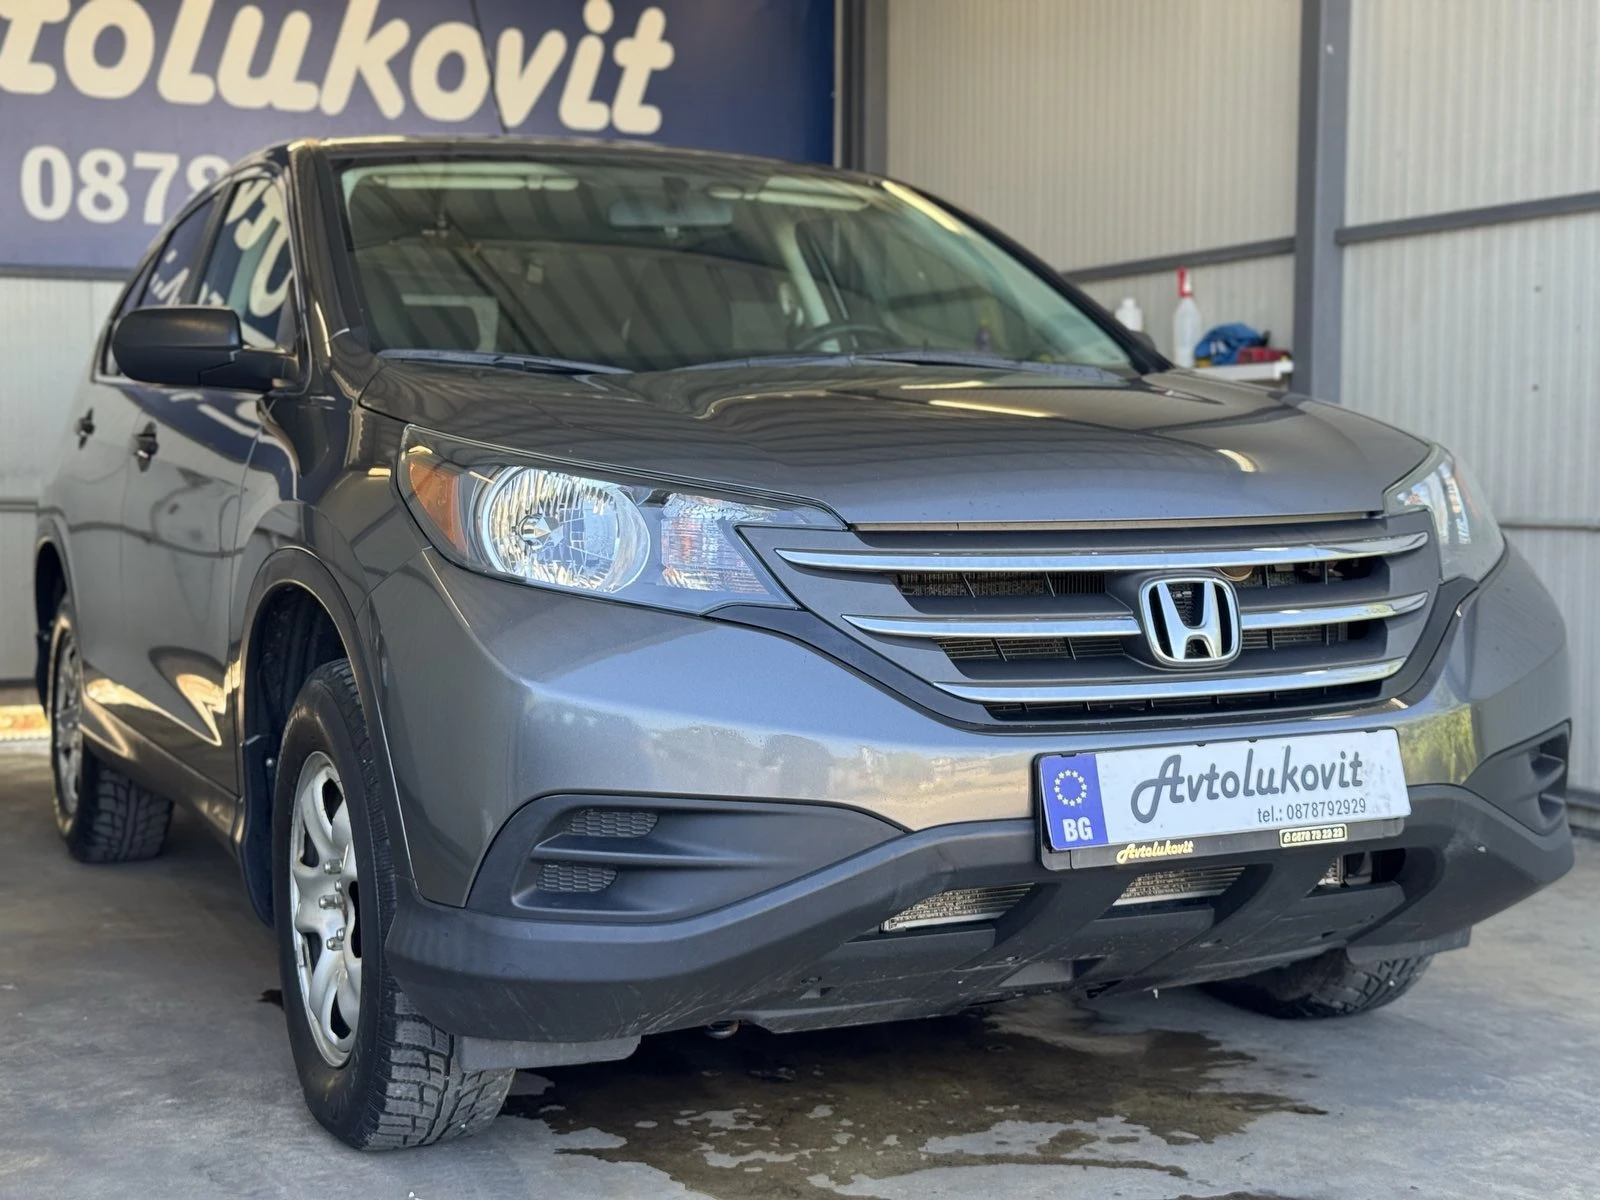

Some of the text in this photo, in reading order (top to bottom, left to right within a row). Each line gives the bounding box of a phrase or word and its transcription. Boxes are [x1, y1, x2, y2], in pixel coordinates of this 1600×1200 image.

[1130, 745, 1364, 824] Avtolukovit
[1257, 797, 1366, 823] tel.: 0878792929
[1062, 817, 1094, 842] BG
[1116, 839, 1194, 864] Avtolukovit
